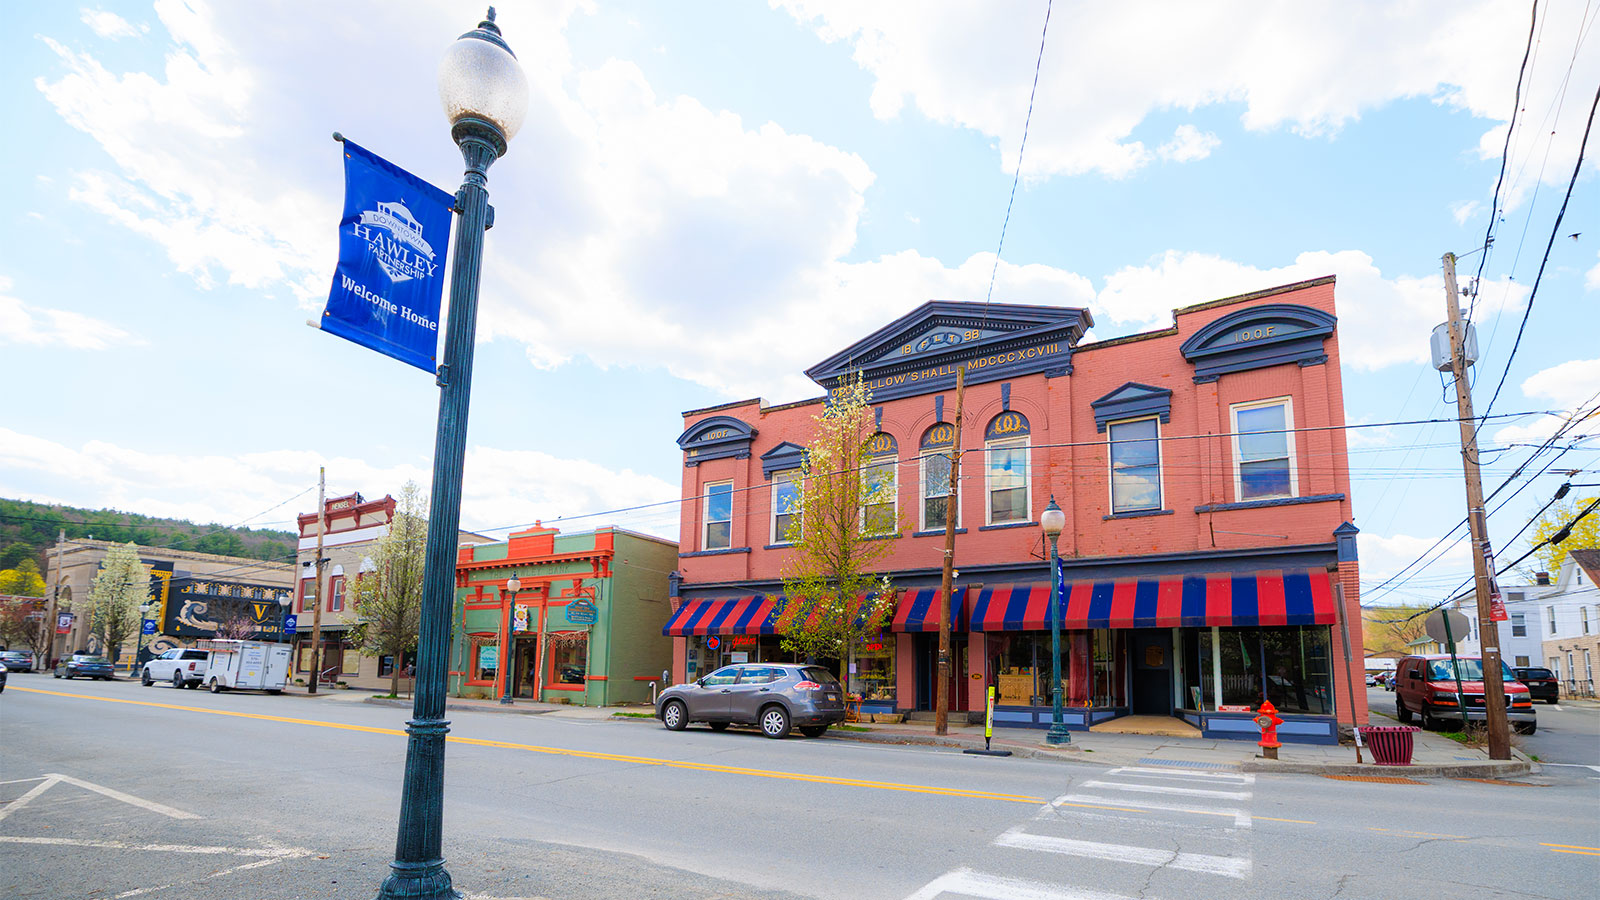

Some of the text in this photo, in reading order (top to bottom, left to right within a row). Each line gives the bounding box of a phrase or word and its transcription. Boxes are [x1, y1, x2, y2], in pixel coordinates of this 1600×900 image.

[373, 214, 425, 248] DOWNTOWN
[352, 222, 439, 277] HAWLEY
[368, 243, 425, 280] PARTNERSHIP
[342, 274, 437, 331] Welcome Home
[901, 344, 912, 355] 18
[921, 341, 927, 349] F
[949, 334, 955, 343] T
[964, 329, 979, 341] 98
[921, 364, 956, 379] HALL
[549, 564, 570, 575] BANK
[253, 604, 267, 620] V
[866, 643, 883, 651] OPEN
